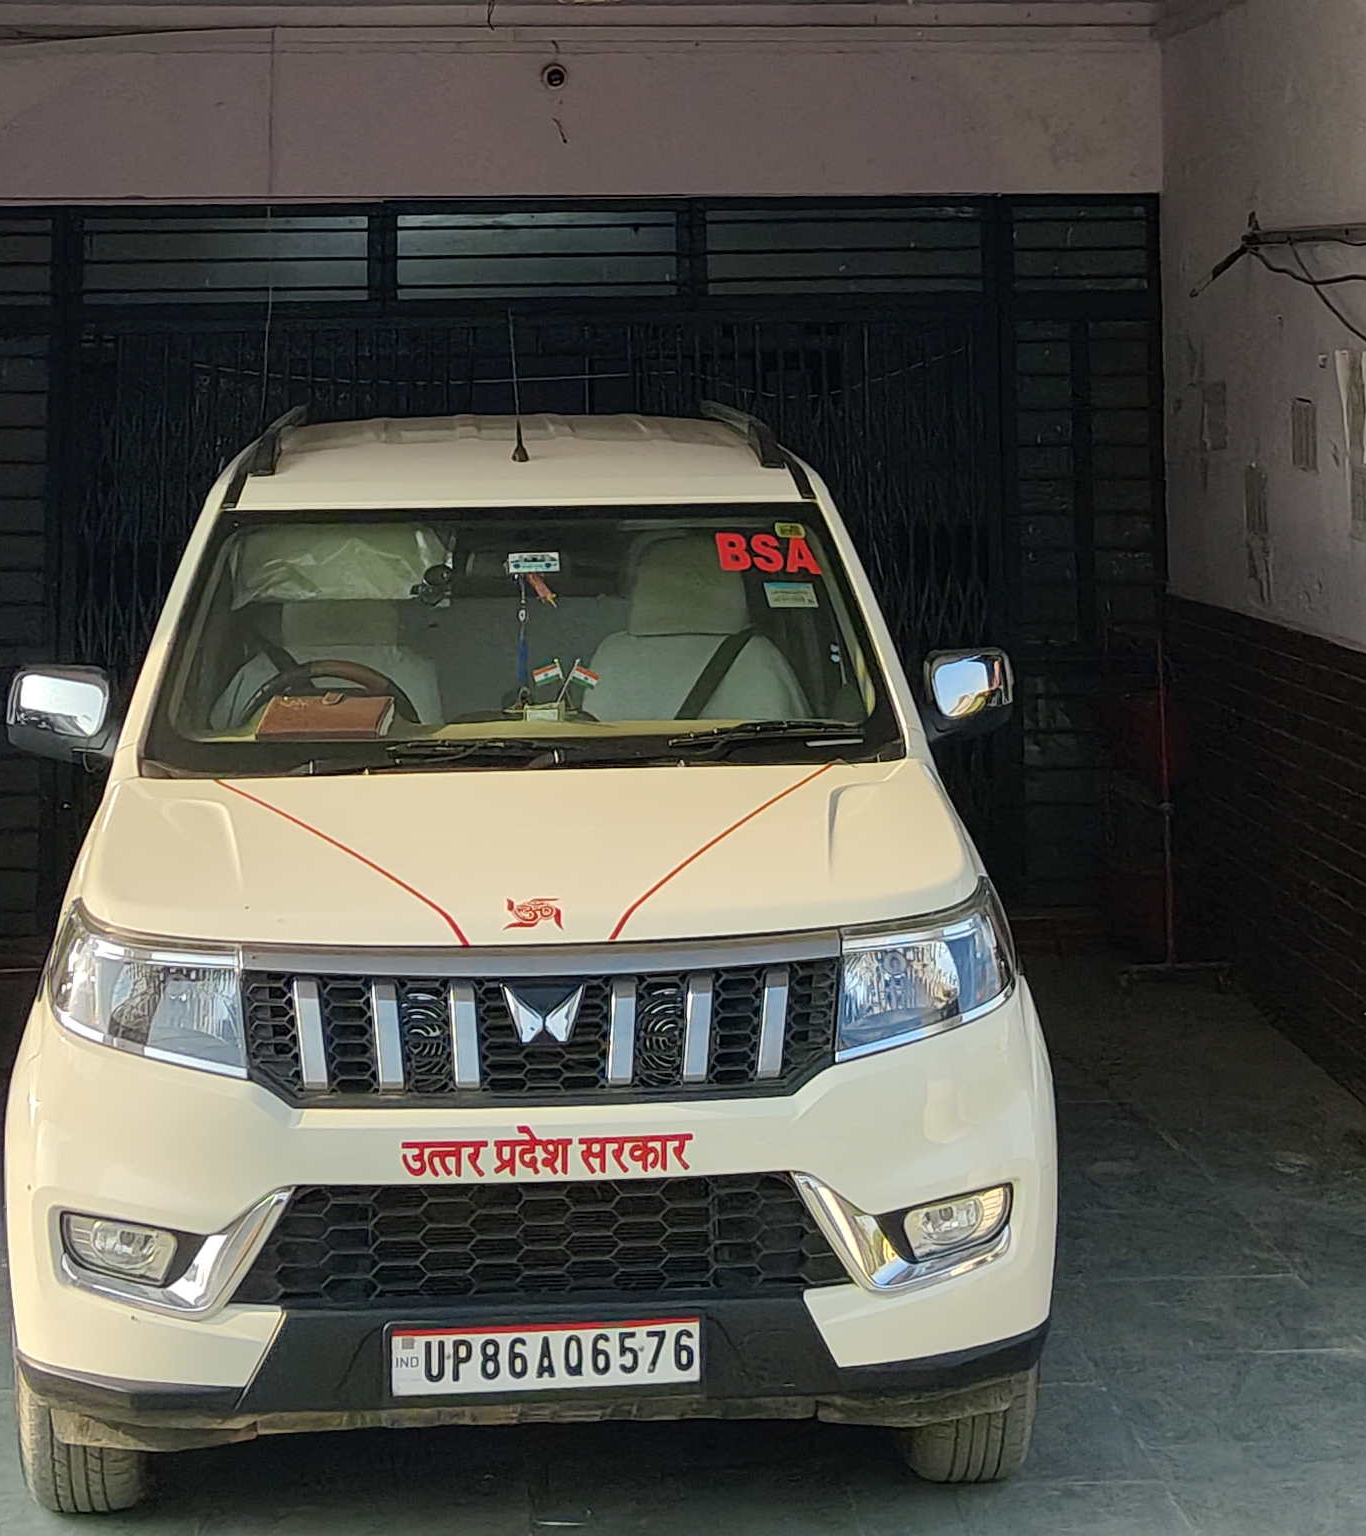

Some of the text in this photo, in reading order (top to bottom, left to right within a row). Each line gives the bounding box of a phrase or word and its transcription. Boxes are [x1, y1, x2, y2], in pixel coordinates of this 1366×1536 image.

[715, 532, 823, 575] BSA
[401, 1125, 694, 1178] उत्तर प्रदेश सरकार
[395, 1328, 696, 1384] IND UP86AQ6576
